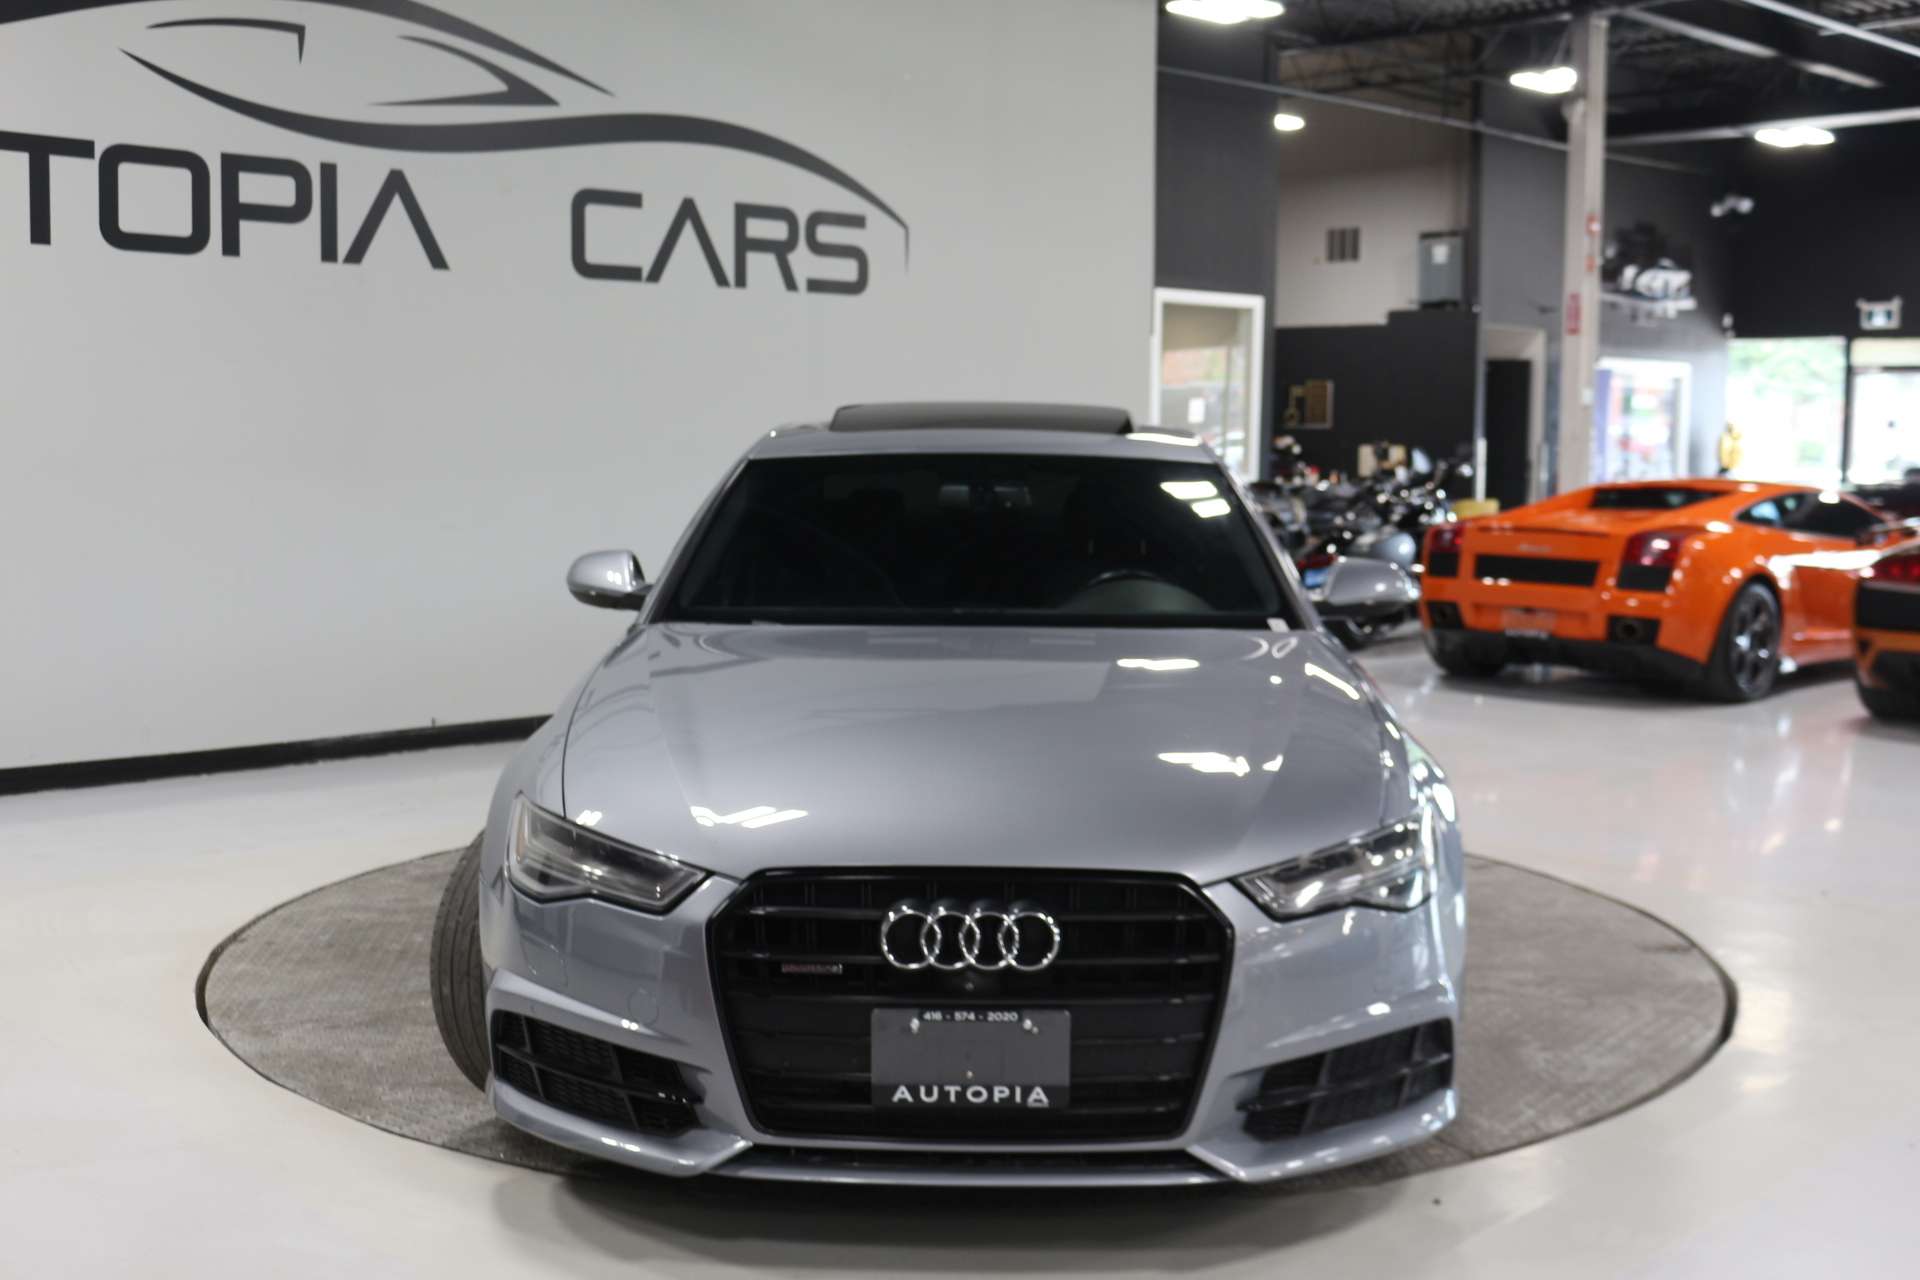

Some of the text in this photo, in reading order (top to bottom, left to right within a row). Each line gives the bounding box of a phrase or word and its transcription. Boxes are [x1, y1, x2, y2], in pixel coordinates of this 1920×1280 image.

[571, 188, 868, 296] CARS
[954, 1011, 976, 1021] 574
[987, 1011, 1018, 1021] 2020
[891, 1085, 1049, 1107] AUTOPIA
